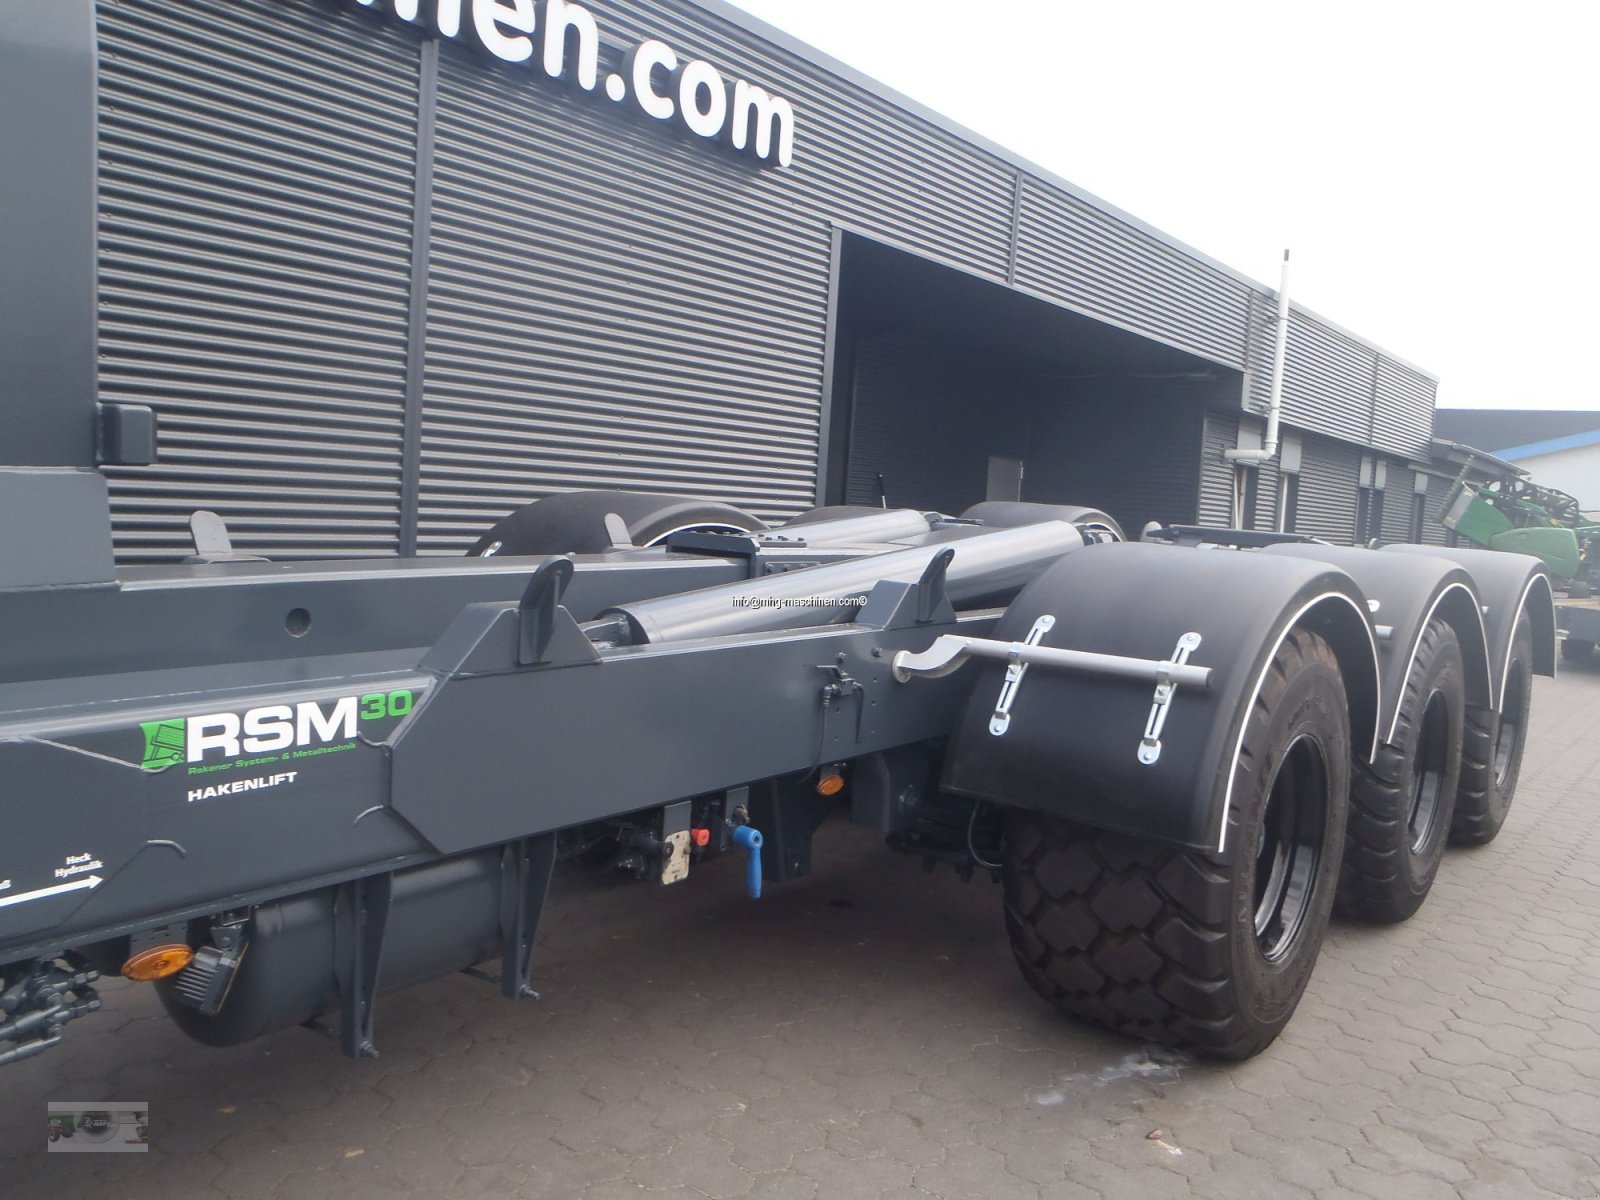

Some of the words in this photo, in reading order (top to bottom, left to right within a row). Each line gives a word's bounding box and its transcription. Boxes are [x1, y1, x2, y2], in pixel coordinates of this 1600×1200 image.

[356, 0, 795, 168] en.com
[187, 696, 358, 763] RSM
[360, 689, 413, 721] 30
[236, 756, 279, 769] System-
[282, 752, 290, 761] &
[293, 742, 357, 759] Metalltechnik
[187, 771, 298, 803] HAKENLIFT
